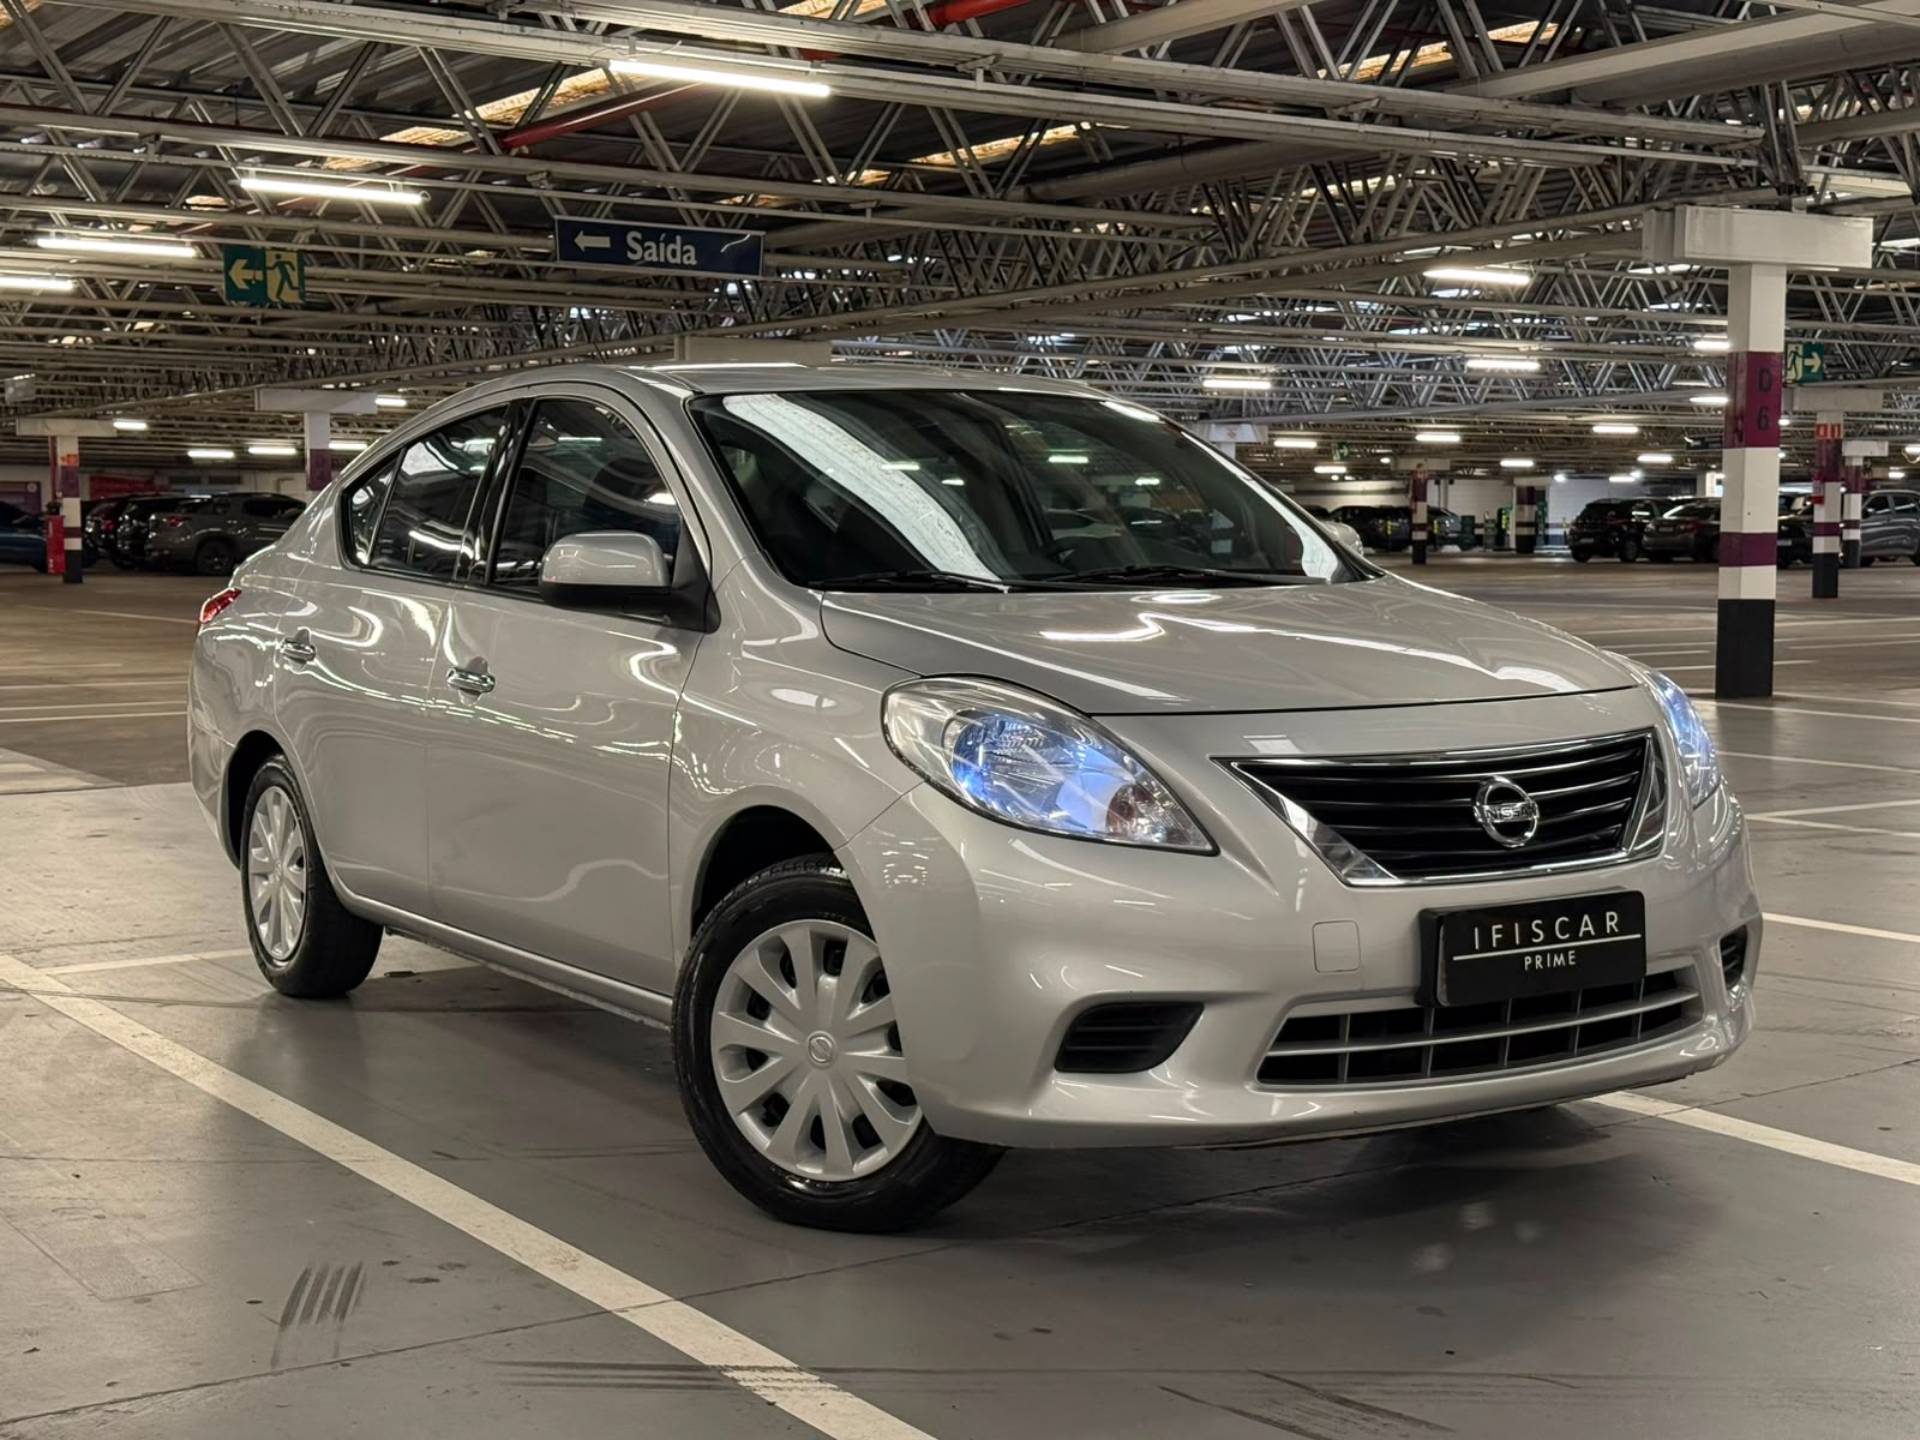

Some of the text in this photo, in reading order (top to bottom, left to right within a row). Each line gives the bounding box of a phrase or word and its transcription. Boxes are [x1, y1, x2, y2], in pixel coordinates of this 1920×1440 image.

[626, 231, 697, 265] Saída
[1757, 367, 1773, 431] D 6
[1475, 911, 1619, 949] IFISCAR
[1524, 951, 1576, 970] PRIME
